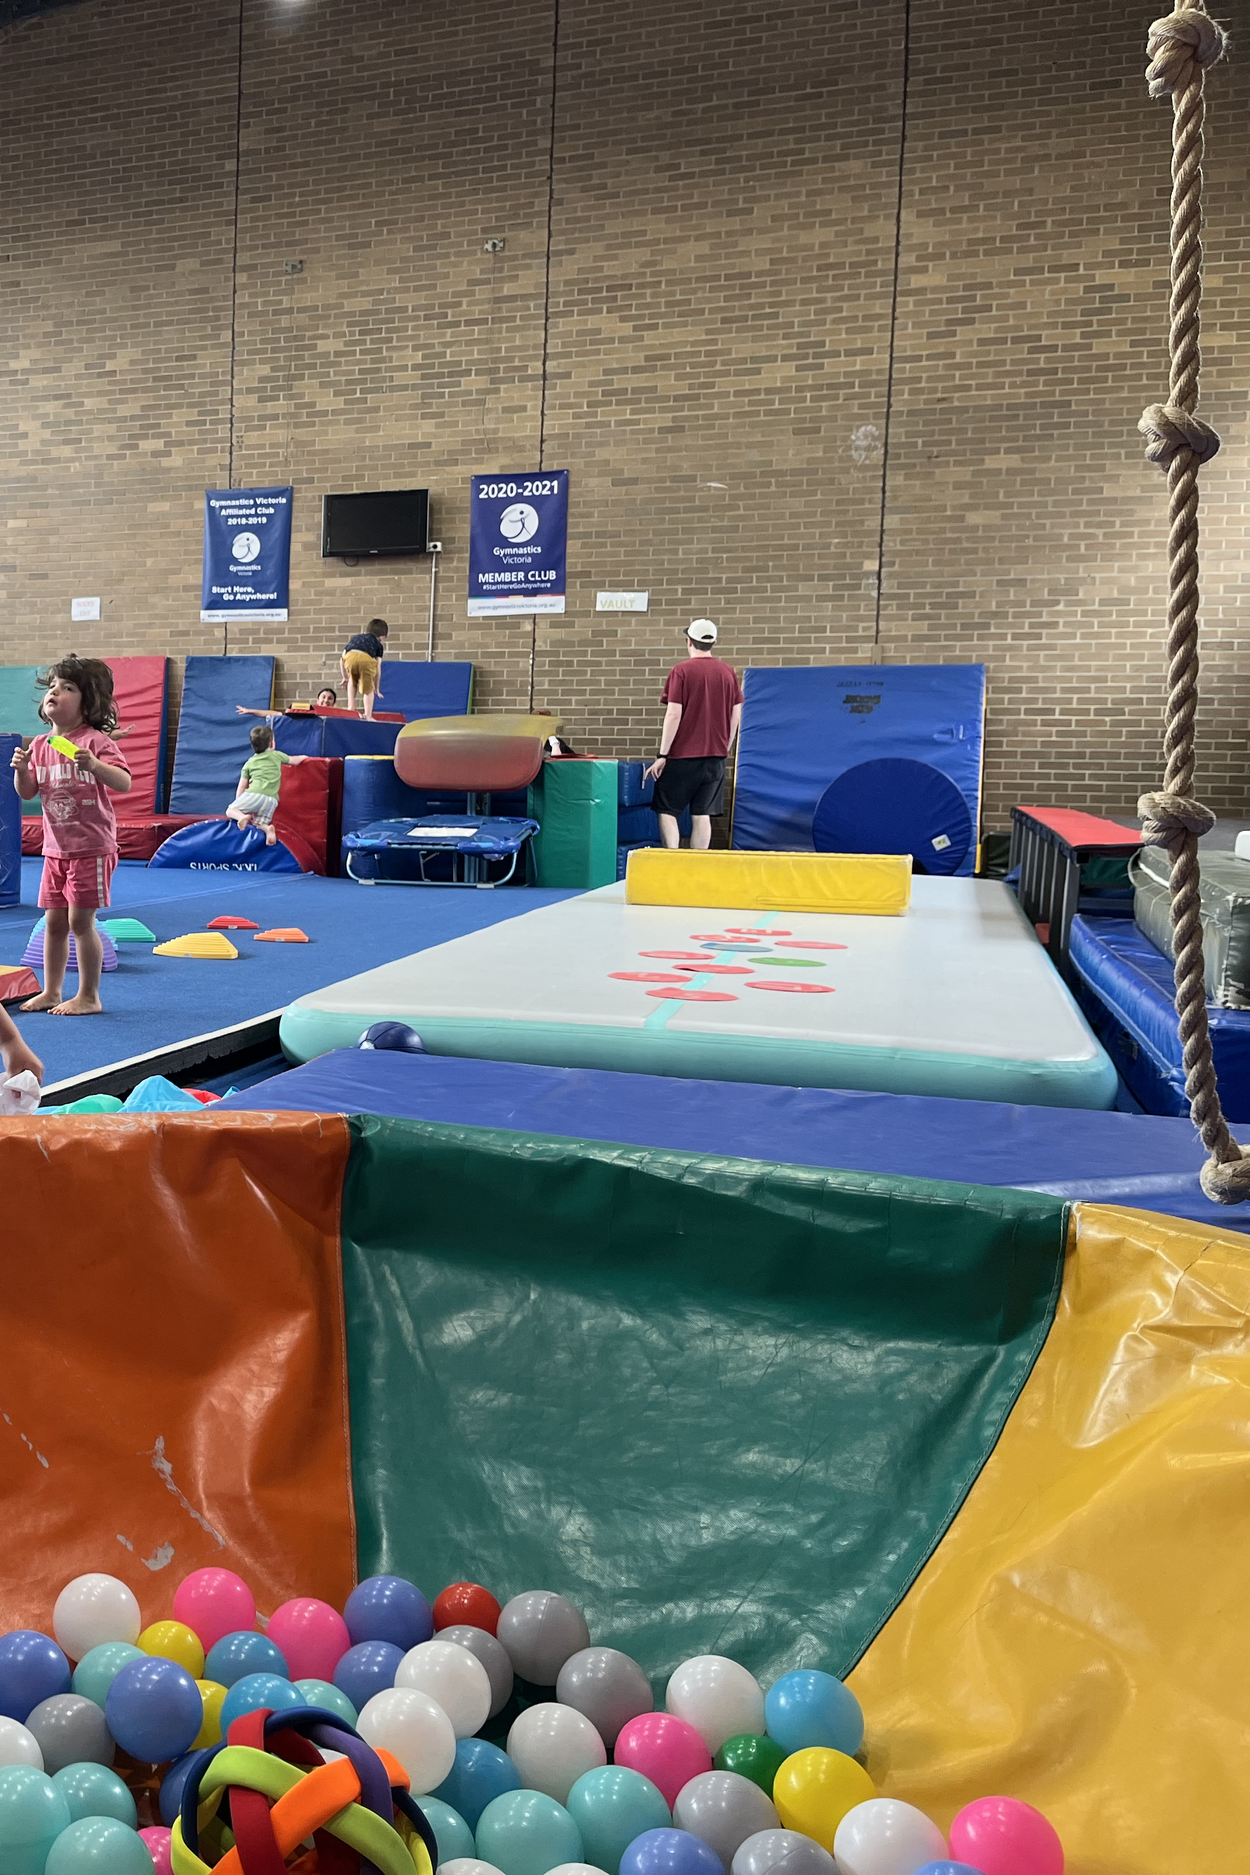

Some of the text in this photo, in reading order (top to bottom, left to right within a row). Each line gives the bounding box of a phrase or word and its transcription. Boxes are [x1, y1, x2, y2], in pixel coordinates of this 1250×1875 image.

[478, 480, 559, 499] 2020-2021
[210, 497, 287, 507] Gymnastics Victoria
[220, 508, 255, 516] Affiliated
[227, 517, 267, 525] 2018-2019
[493, 545, 542, 557] Gymnastics
[502, 555, 532, 565] Victoria
[229, 565, 261, 573] Gymnastics
[478, 570, 557, 583] MEMBER CLUB
[212, 585, 255, 594] Start Here,
[482, 582, 551, 591] #StartHereGoAnywhere
[223, 592, 277, 601] Go Anywhere!
[600, 600, 635, 609] VAULT
